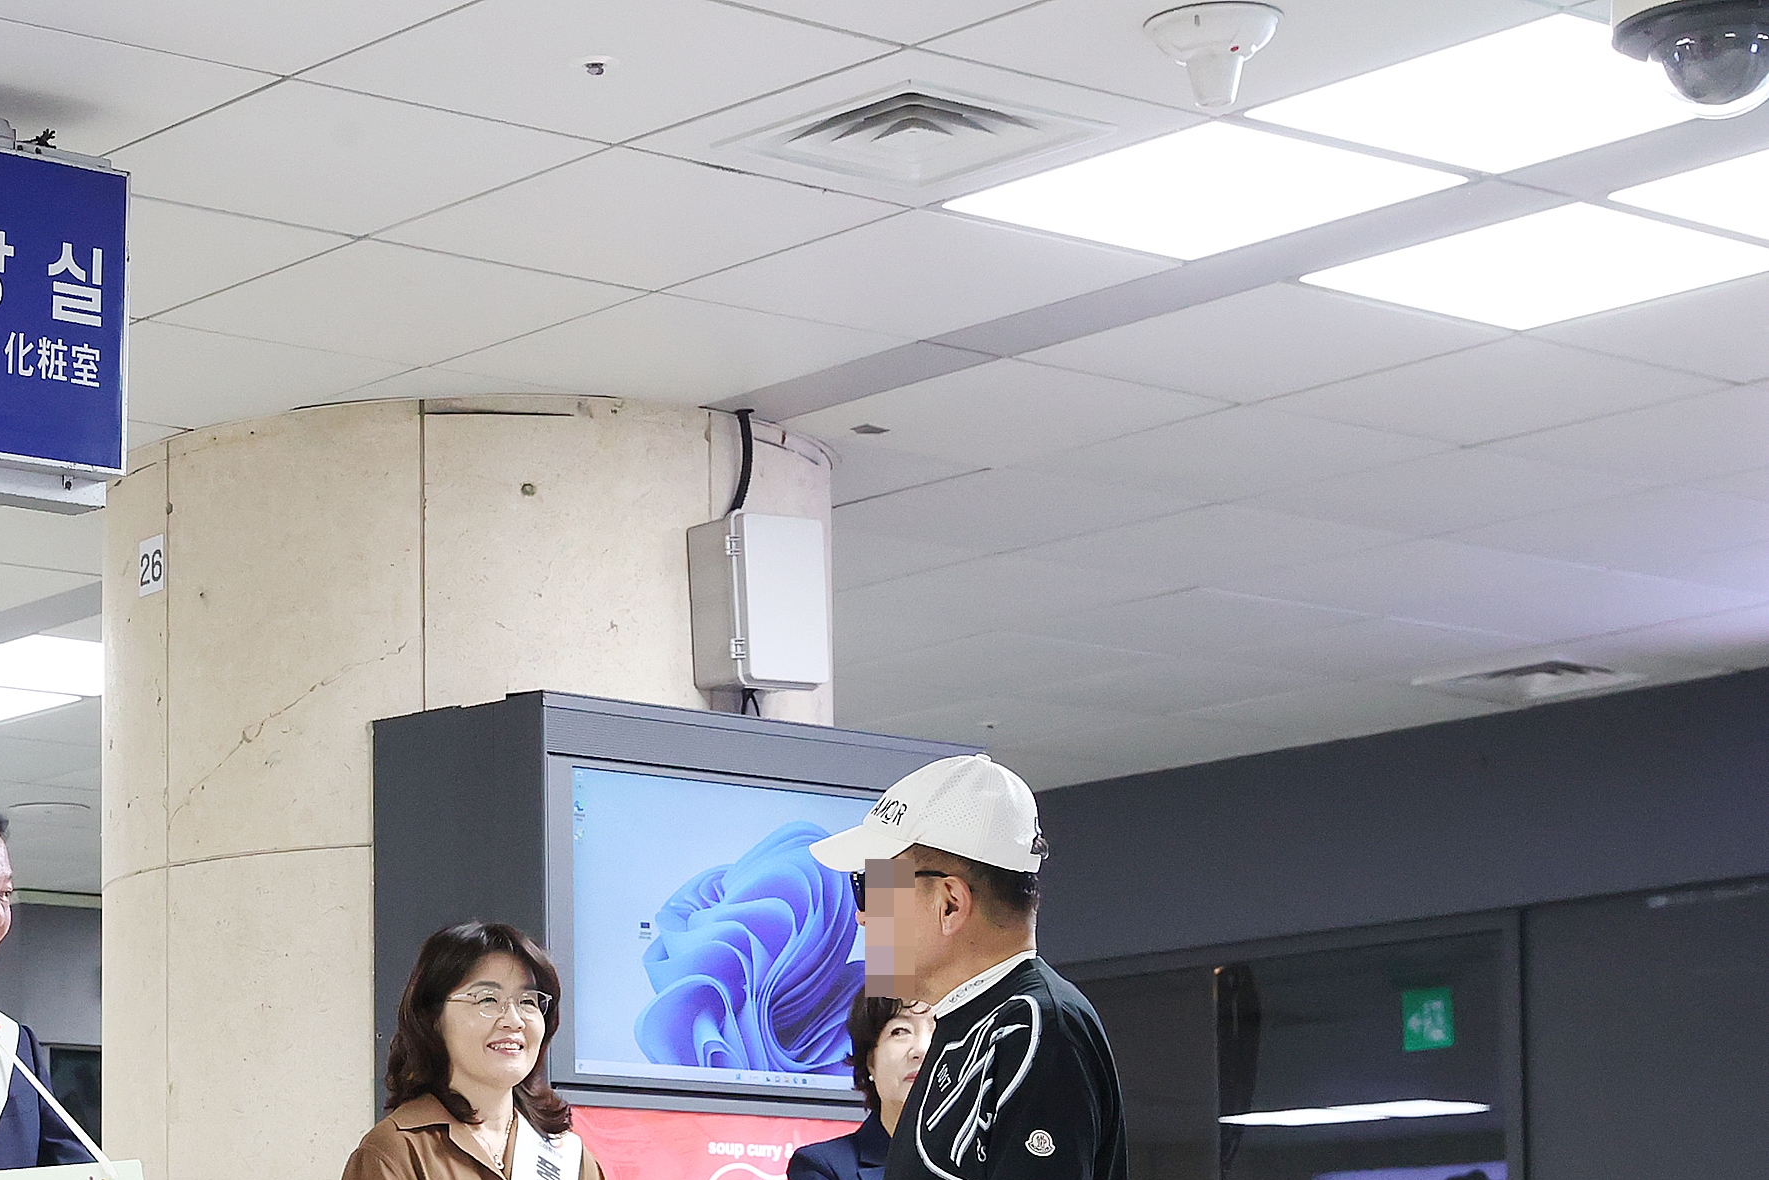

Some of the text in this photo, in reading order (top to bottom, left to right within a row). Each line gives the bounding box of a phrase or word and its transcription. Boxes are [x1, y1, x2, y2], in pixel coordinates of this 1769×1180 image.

[3, 331, 102, 388] 化粧室
[140, 549, 162, 587] 26
[708, 1141, 745, 1160] soup
[746, 1143, 783, 1162] curry
